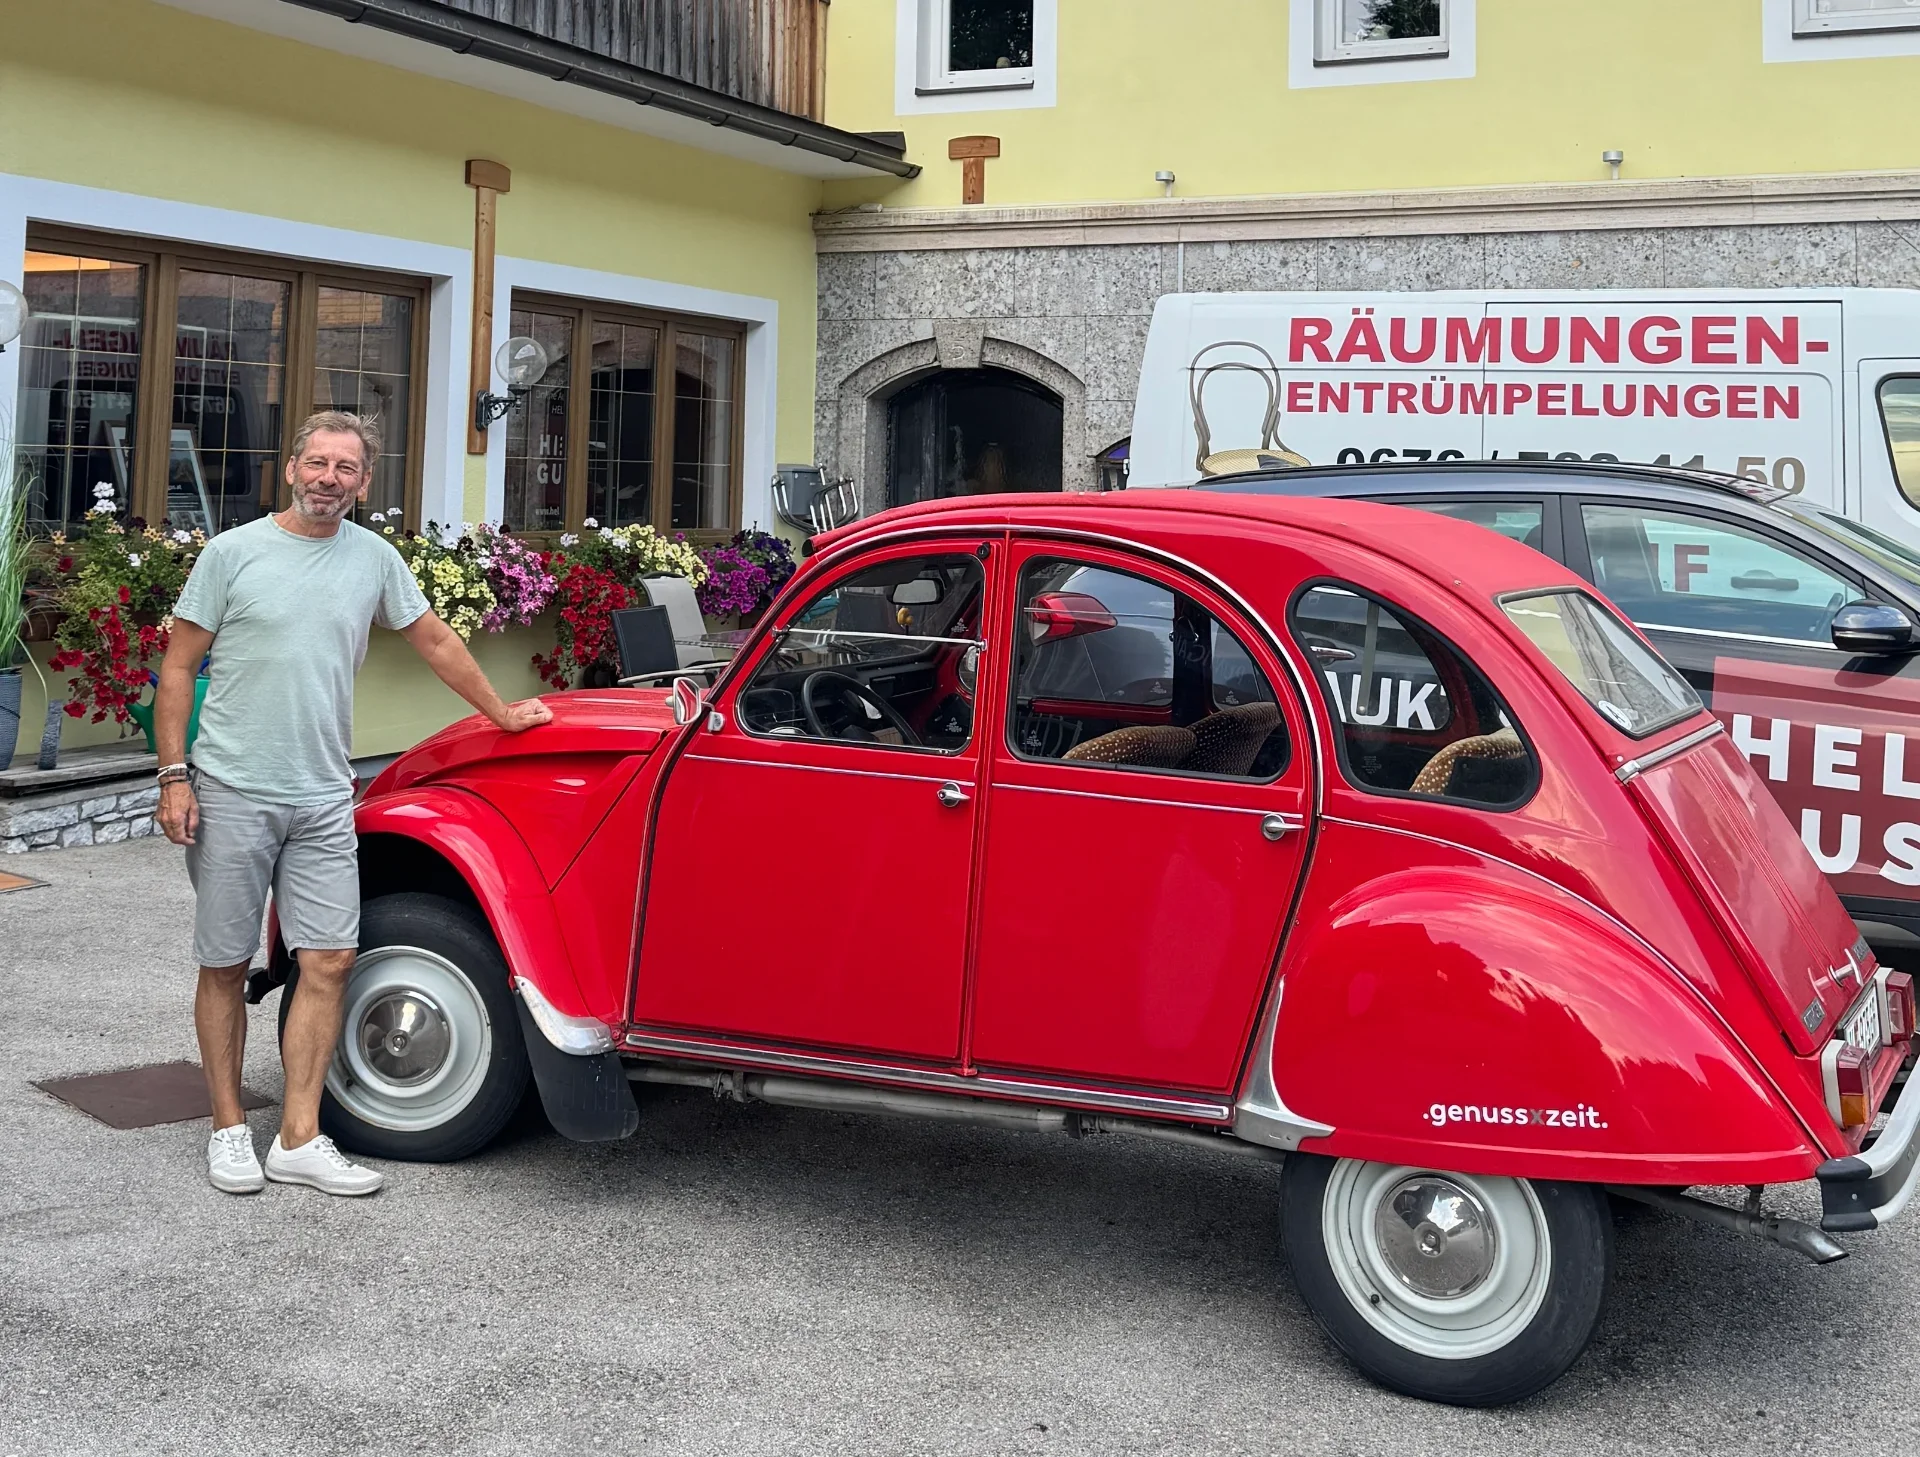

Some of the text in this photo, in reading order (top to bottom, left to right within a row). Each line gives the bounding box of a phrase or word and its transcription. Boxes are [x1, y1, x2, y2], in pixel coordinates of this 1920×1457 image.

[1288, 307, 1829, 365] RÄUMUNGEN-
[1286, 375, 1800, 420] ENTRÜMPELUNGEN
[1650, 543, 1710, 592] F
[1324, 670, 1447, 731] UK
[1732, 713, 1920, 800] HEL
